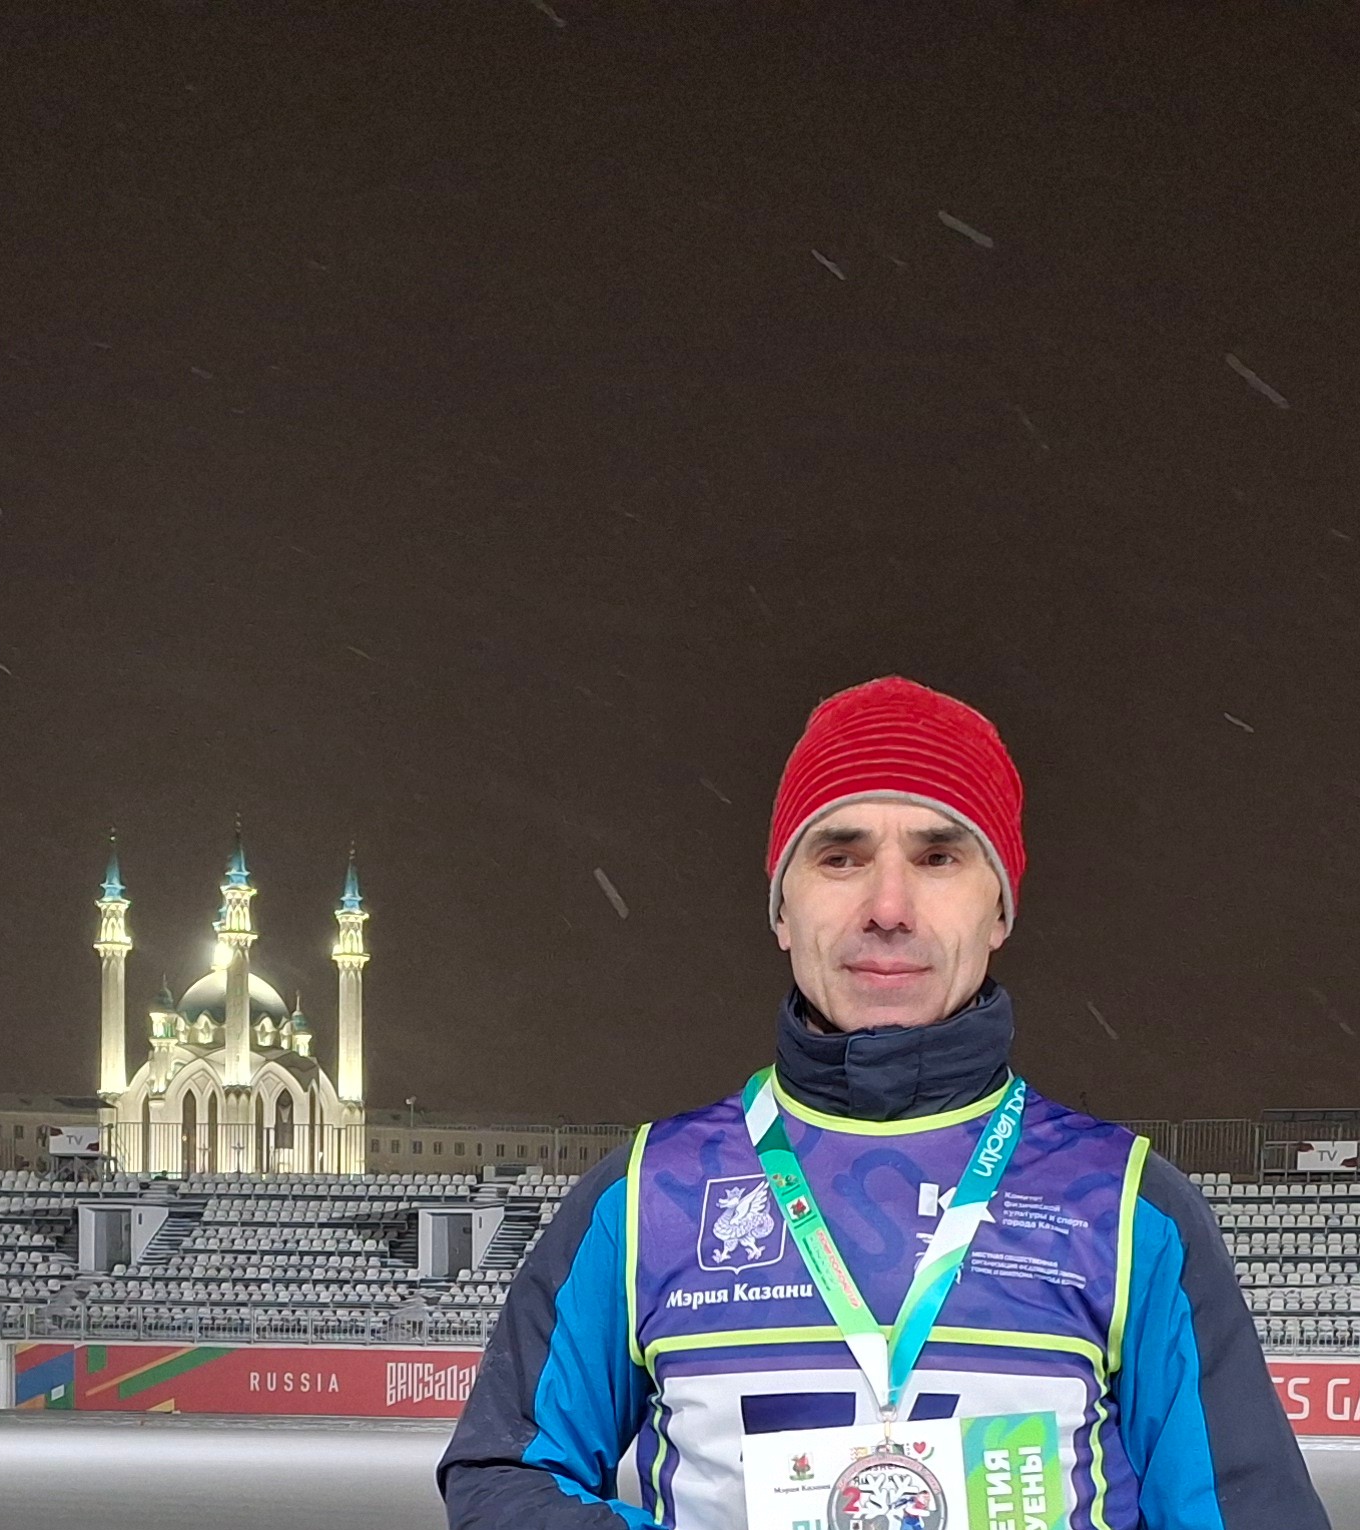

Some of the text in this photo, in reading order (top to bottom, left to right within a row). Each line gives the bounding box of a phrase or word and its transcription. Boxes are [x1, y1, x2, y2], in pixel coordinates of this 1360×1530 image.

[66, 1134, 84, 1146] TV
[1318, 1150, 1338, 1162] TV
[666, 1283, 813, 1310] Мэрия Казани
[249, 1372, 340, 1393] RUSSIA
